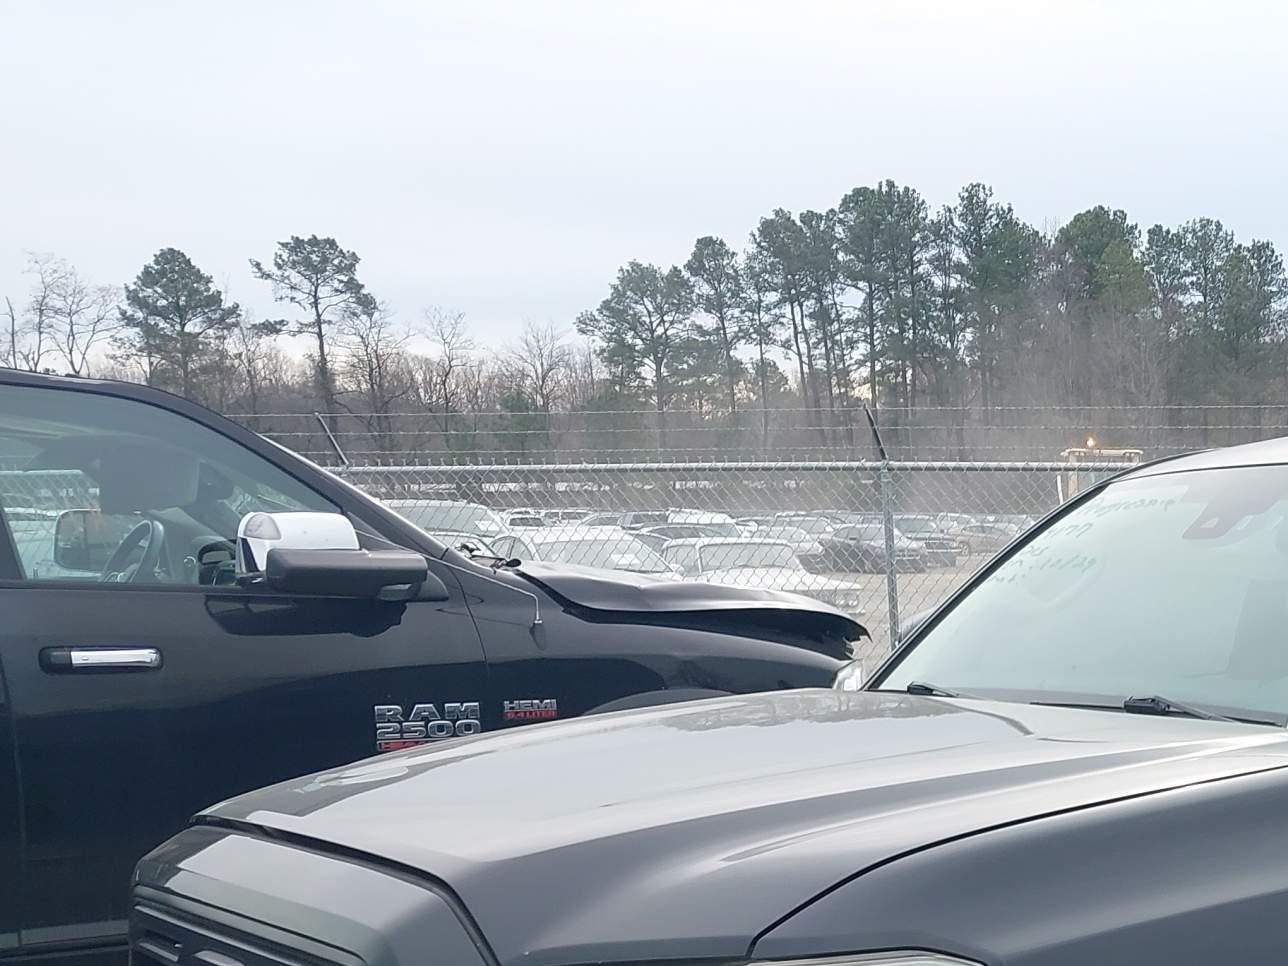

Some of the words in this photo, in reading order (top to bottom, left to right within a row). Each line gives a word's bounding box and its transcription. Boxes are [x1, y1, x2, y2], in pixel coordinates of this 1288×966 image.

[374, 702, 480, 721] RAM
[504, 699, 557, 712] HEMI
[376, 720, 480, 739] 2500
